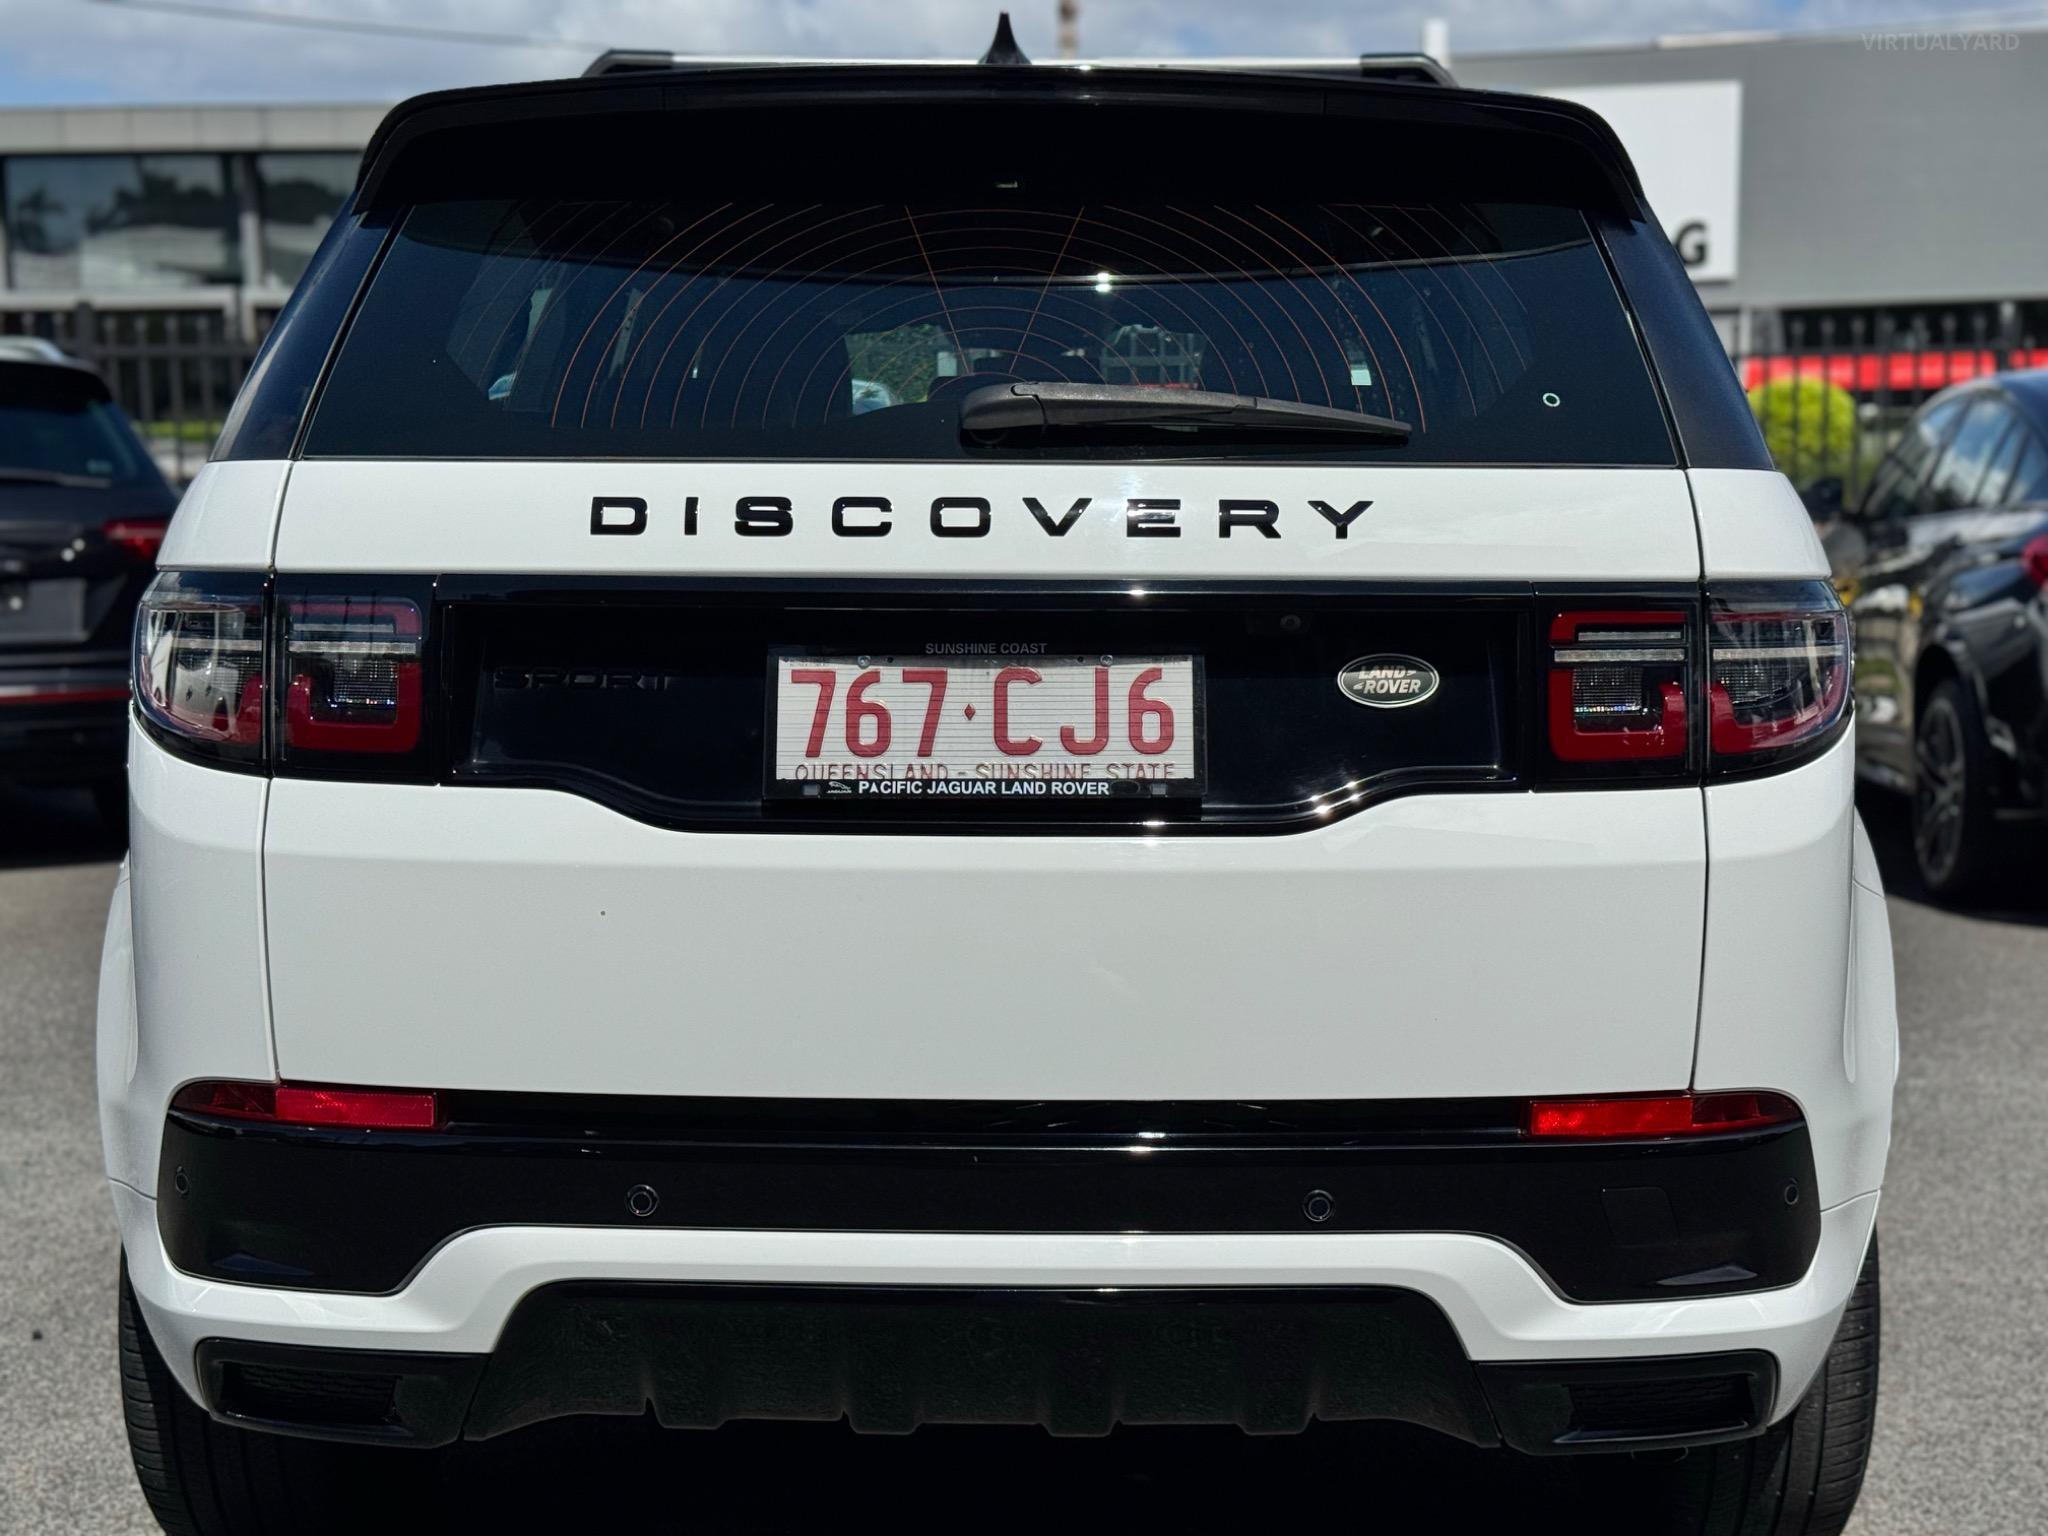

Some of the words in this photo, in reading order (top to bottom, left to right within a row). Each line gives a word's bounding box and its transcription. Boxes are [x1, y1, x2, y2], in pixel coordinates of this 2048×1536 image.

[590, 496, 1375, 539] DISCOVERY
[925, 642, 997, 654] SUNSHINE
[1000, 642, 1048, 654] COAST
[1358, 665, 1407, 680] LAND
[1363, 679, 1422, 694] ROVER
[795, 763, 949, 780] QUEENSLAND
[975, 763, 1091, 779] SUNSHINE
[1106, 763, 1176, 779] STATE
[858, 780, 923, 795] PACIFIC
[926, 780, 997, 795] JAGUAR
[1001, 781, 1047, 795] LAND
[1051, 781, 1110, 796] ROVER
